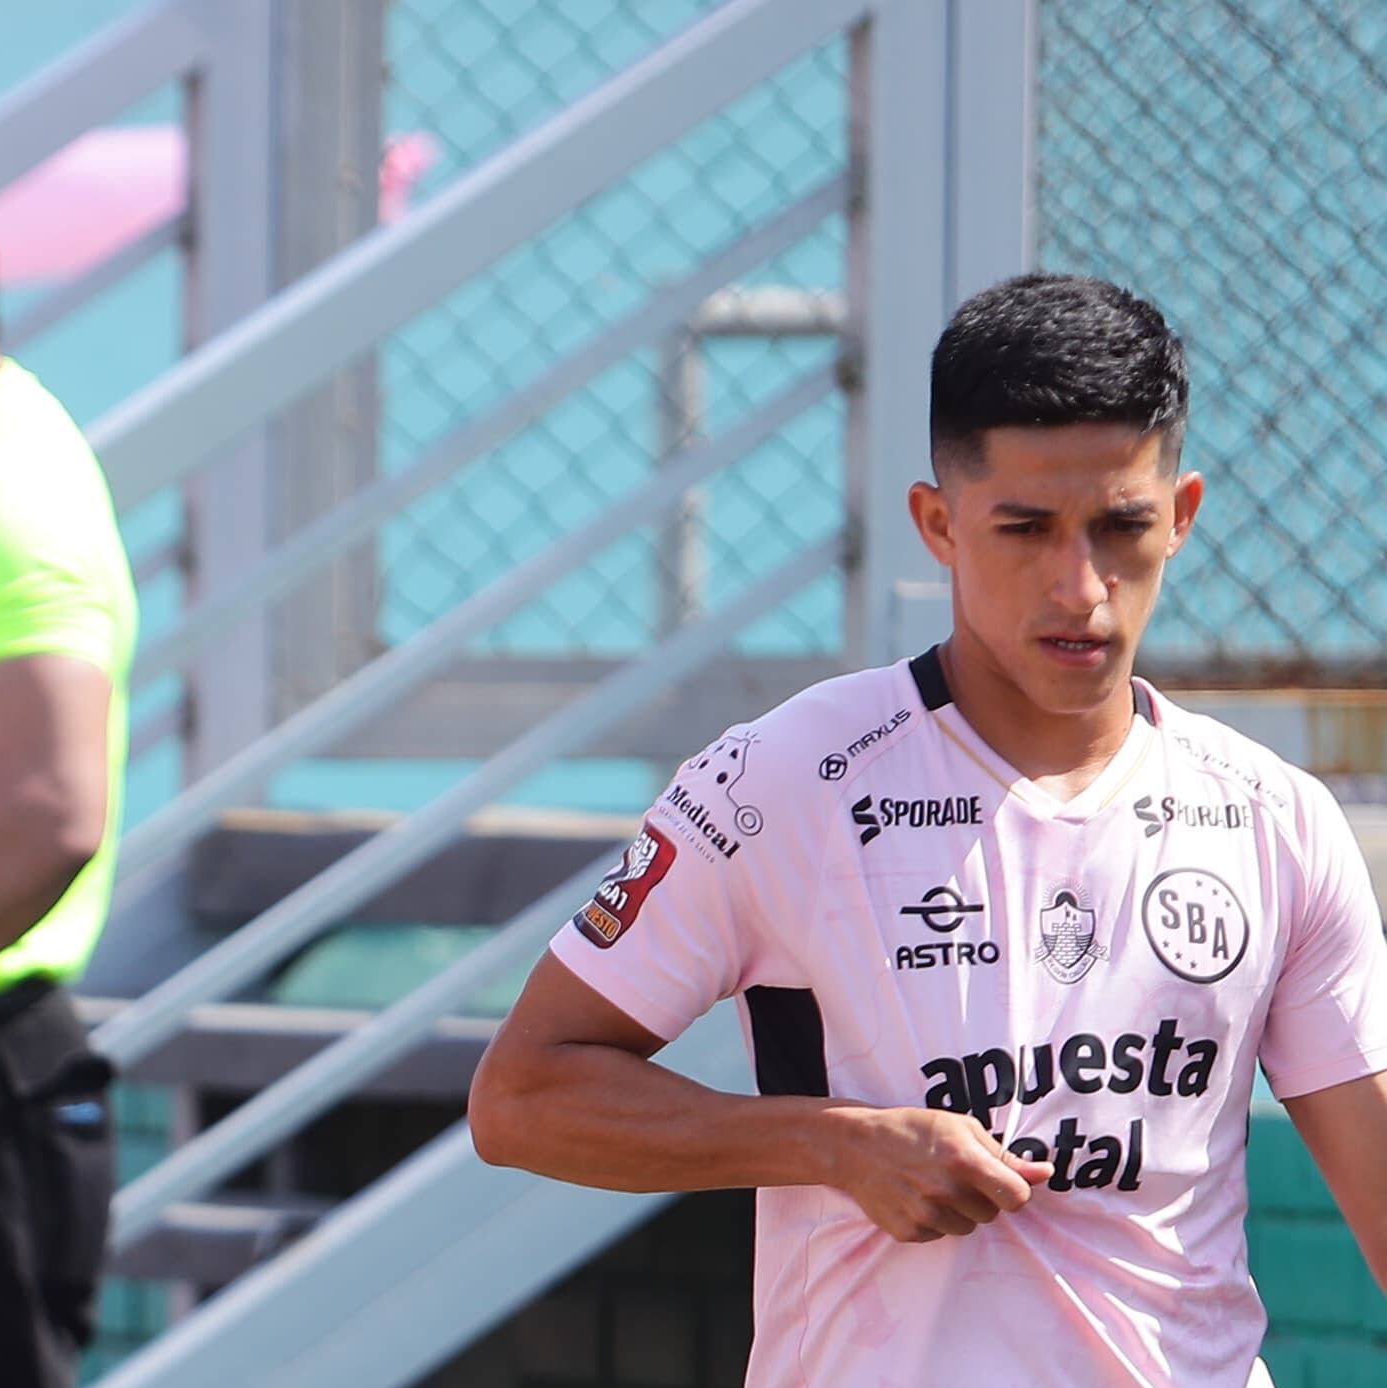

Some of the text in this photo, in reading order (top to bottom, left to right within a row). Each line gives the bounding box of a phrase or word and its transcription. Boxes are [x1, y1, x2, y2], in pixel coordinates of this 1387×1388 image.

[847, 708, 912, 758] MAXUS
[667, 785, 740, 858] Medical
[879, 796, 984, 828] SPORADE
[896, 940, 1000, 970] ASTRO
[1158, 888, 1230, 960] SBA
[920, 1018, 1219, 1131] apuesta
[991, 1115, 1147, 1193] otal
